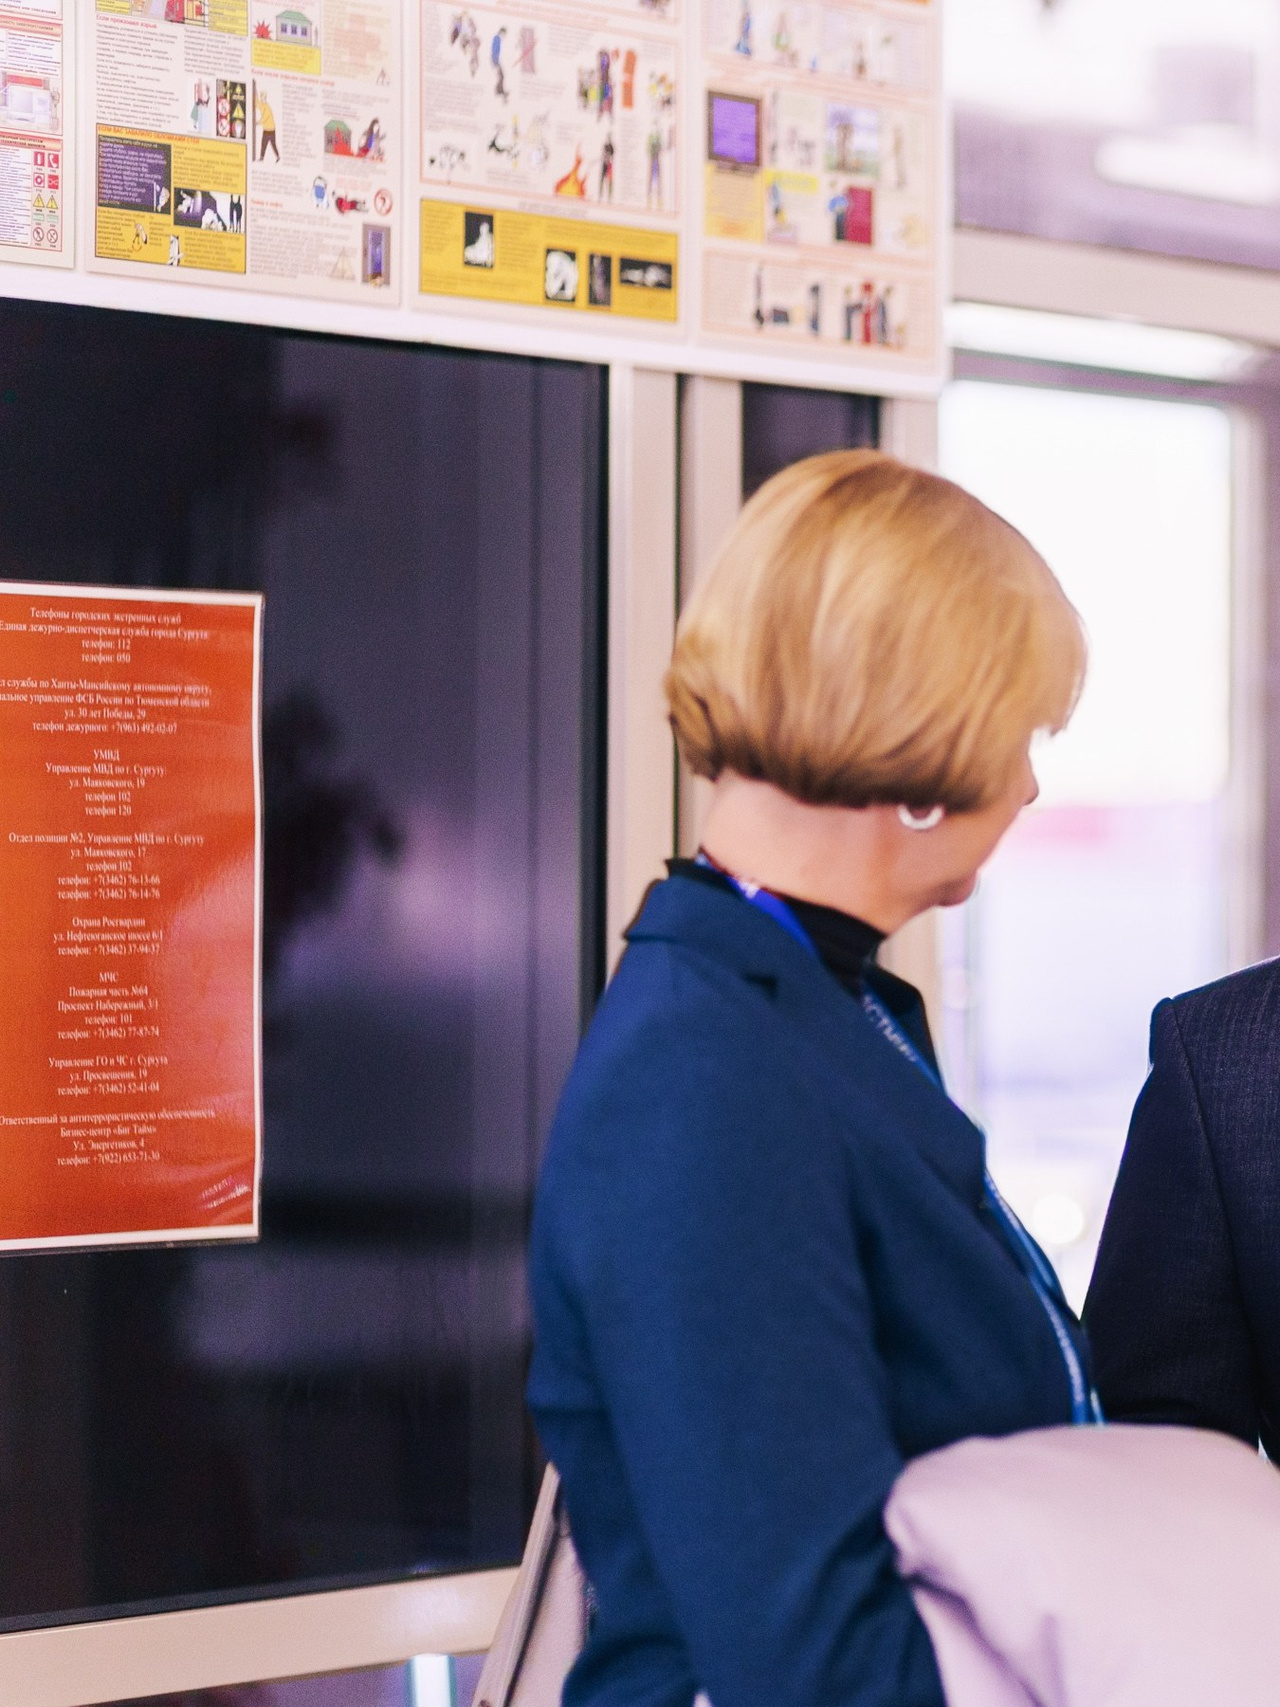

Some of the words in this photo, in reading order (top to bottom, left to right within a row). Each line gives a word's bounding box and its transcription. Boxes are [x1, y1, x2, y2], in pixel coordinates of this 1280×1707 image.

[30, 607, 69, 621] Телефоны
[71, 612, 111, 622] городских
[117, 638, 131, 651] 112
[7, 677, 38, 690] службы
[39, 680, 50, 689] по
[29, 693, 74, 705] управление
[75, 692, 95, 704] ФСБ
[96, 693, 123, 705] России
[78, 707, 88, 718] 30
[32, 720, 64, 734] телефон
[93, 748, 120, 762] УМВД
[45, 762, 92, 776] Управление
[93, 763, 114, 776] МВД
[115, 765, 125, 774] по
[136, 777, 146, 789] 19
[85, 790, 116, 804] телефон
[118, 790, 131, 803] 102
[85, 805, 117, 818] телефон
[118, 804, 132, 817] 120
[8, 832, 33, 844] Отдел
[34, 834, 69, 844] полиции
[87, 832, 133, 847] Управление
[134, 832, 155, 846] МВД
[137, 845, 147, 858] 17
[86, 859, 117, 874] телефон
[119, 860, 132, 873] 102
[72, 916, 101, 930] Охрана
[99, 971, 119, 984] МЧС
[69, 986, 107, 1000] Пожарная
[57, 1000, 94, 1015] Проспект
[120, 1012, 133, 1025] 101
[48, 1056, 95, 1070] Управление
[96, 1054, 109, 1067] ГО
[109, 1057, 115, 1067] и
[116, 1053, 129, 1067] ЧС
[138, 1067, 148, 1080] 19
[59, 1115, 68, 1124] за
[139, 1136, 146, 1149] 4
